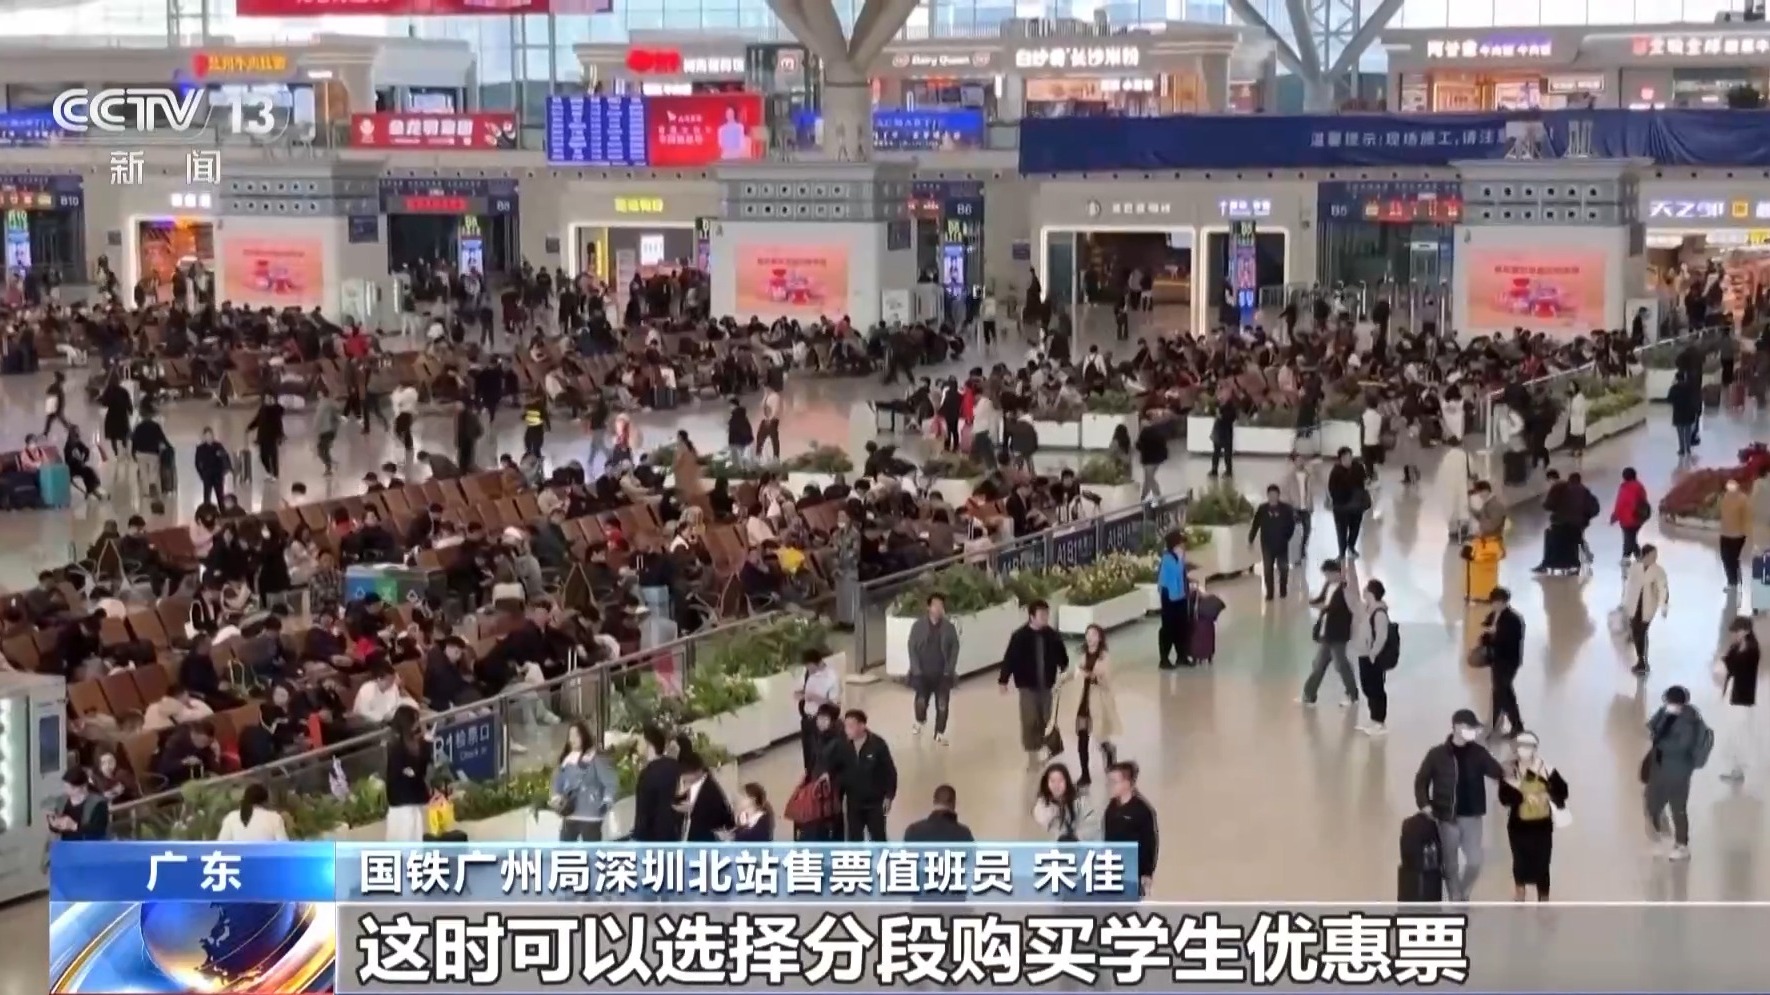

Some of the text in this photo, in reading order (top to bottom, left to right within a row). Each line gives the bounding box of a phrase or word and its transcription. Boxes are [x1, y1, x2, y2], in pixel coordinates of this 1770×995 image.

[60, 195, 79, 206] B10
[455, 723, 490, 749] 检票口
